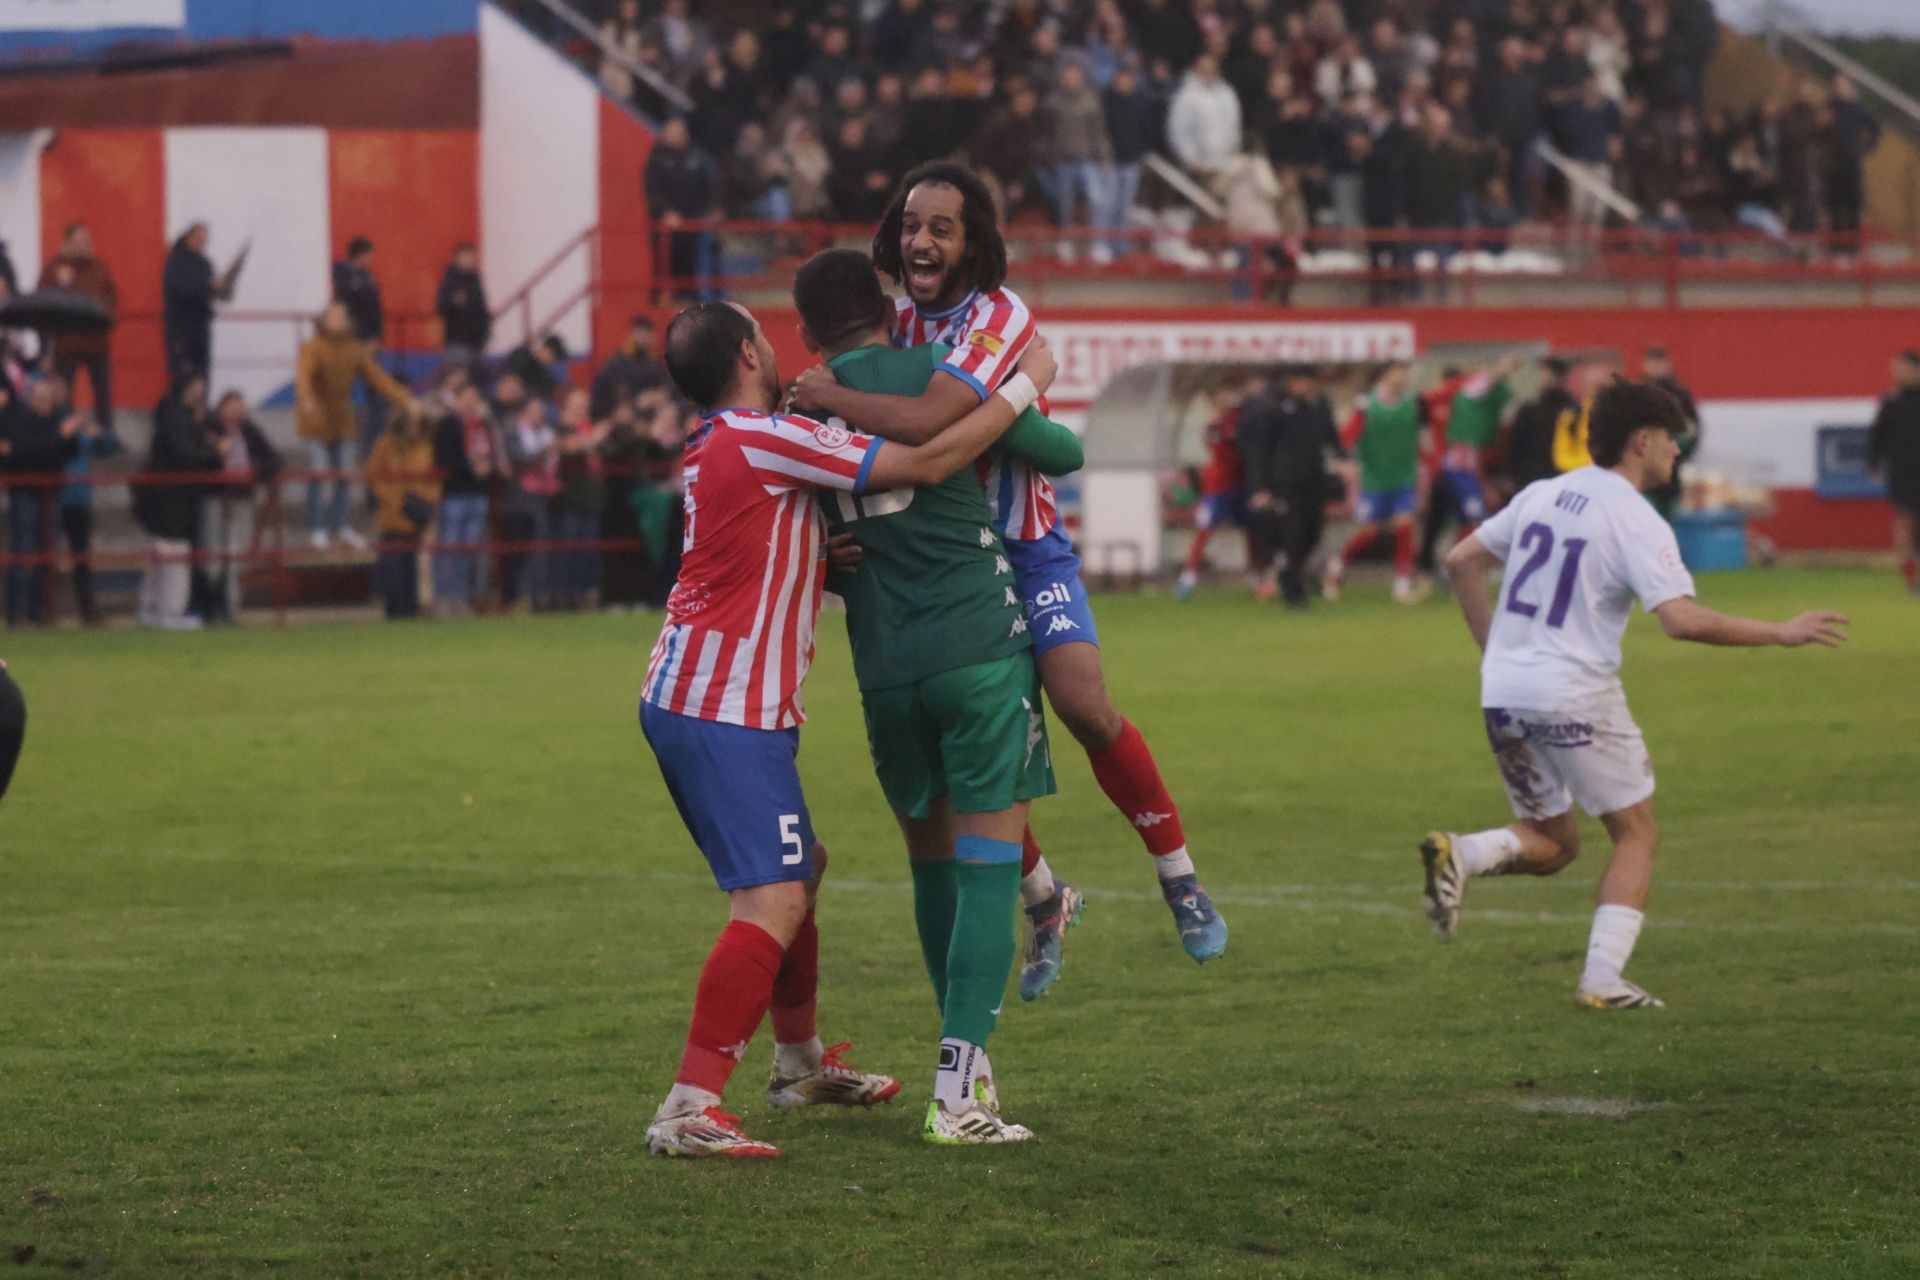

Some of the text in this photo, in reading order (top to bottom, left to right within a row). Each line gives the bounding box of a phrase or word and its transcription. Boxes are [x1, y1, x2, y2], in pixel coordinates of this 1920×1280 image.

[1036, 582, 1072, 606] oil
[1506, 521, 1588, 629] 21
[778, 814, 803, 865] 5
